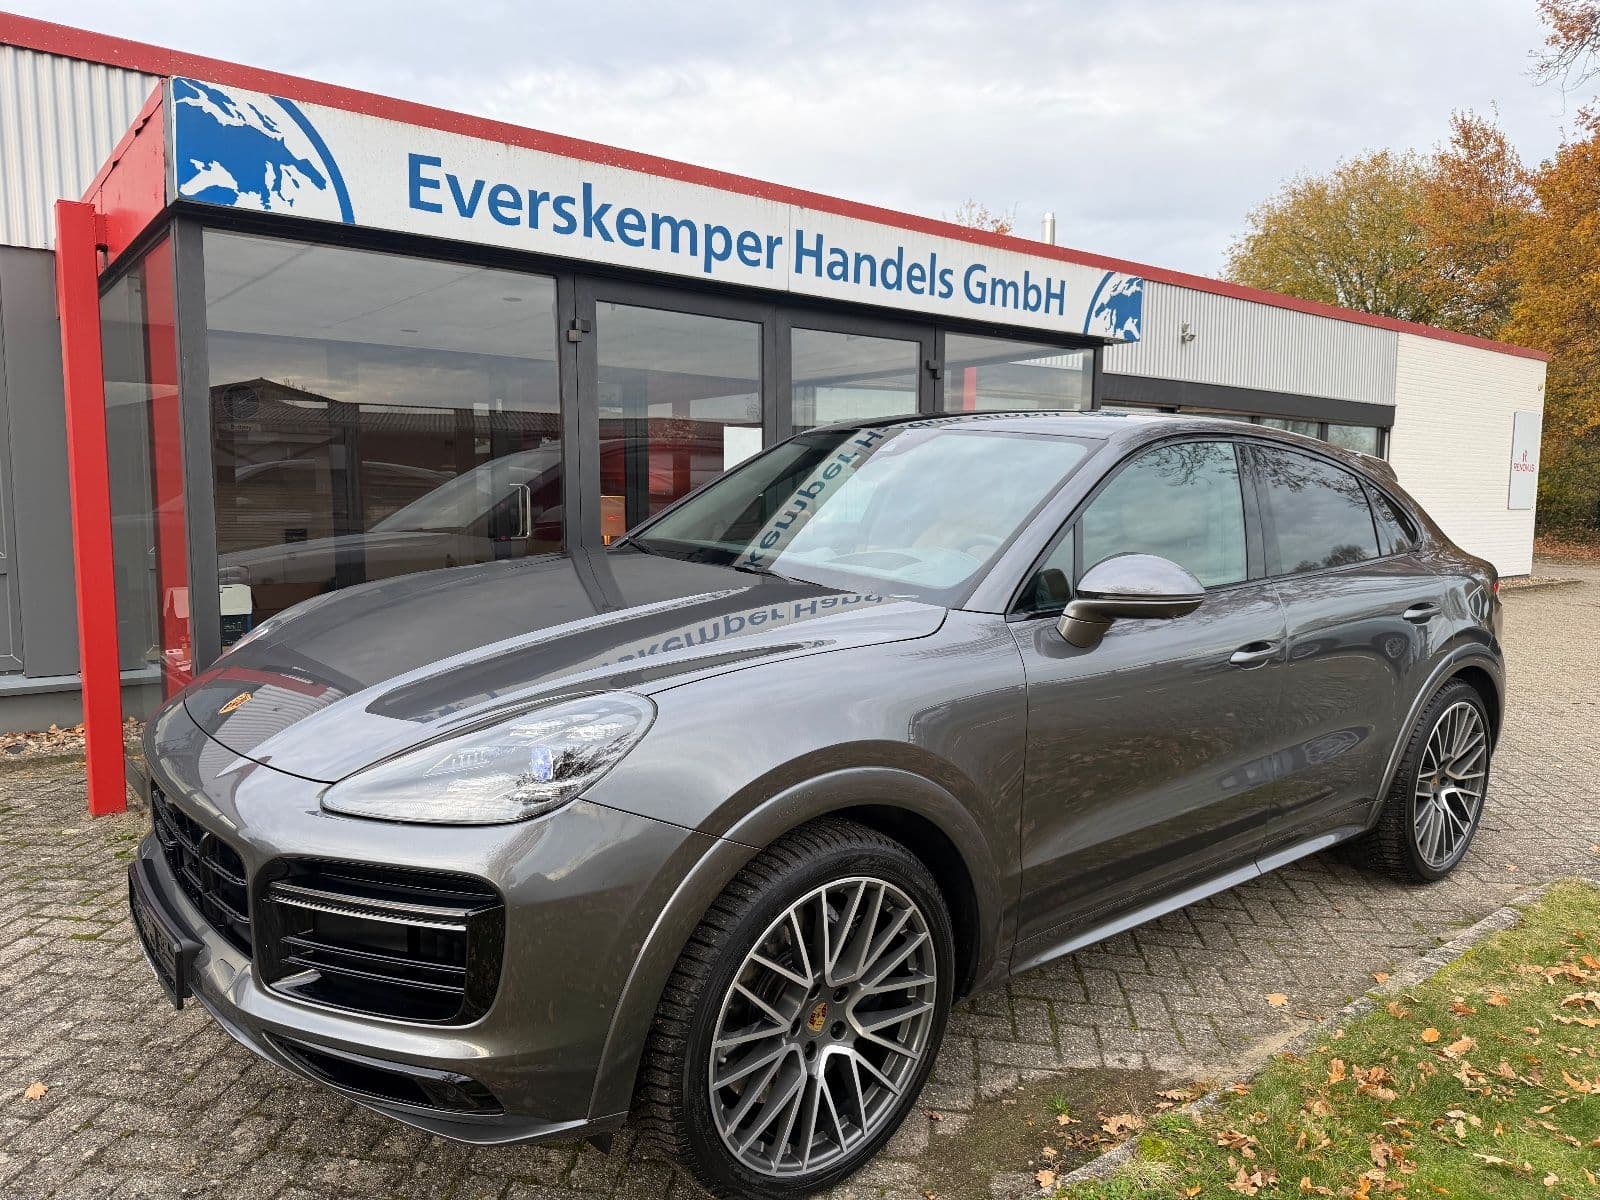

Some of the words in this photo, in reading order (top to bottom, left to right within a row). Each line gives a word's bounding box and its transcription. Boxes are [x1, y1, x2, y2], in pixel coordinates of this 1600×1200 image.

[408, 152, 783, 273] Everskemper
[794, 229, 954, 300] Handels
[963, 263, 1066, 316] GmbH
